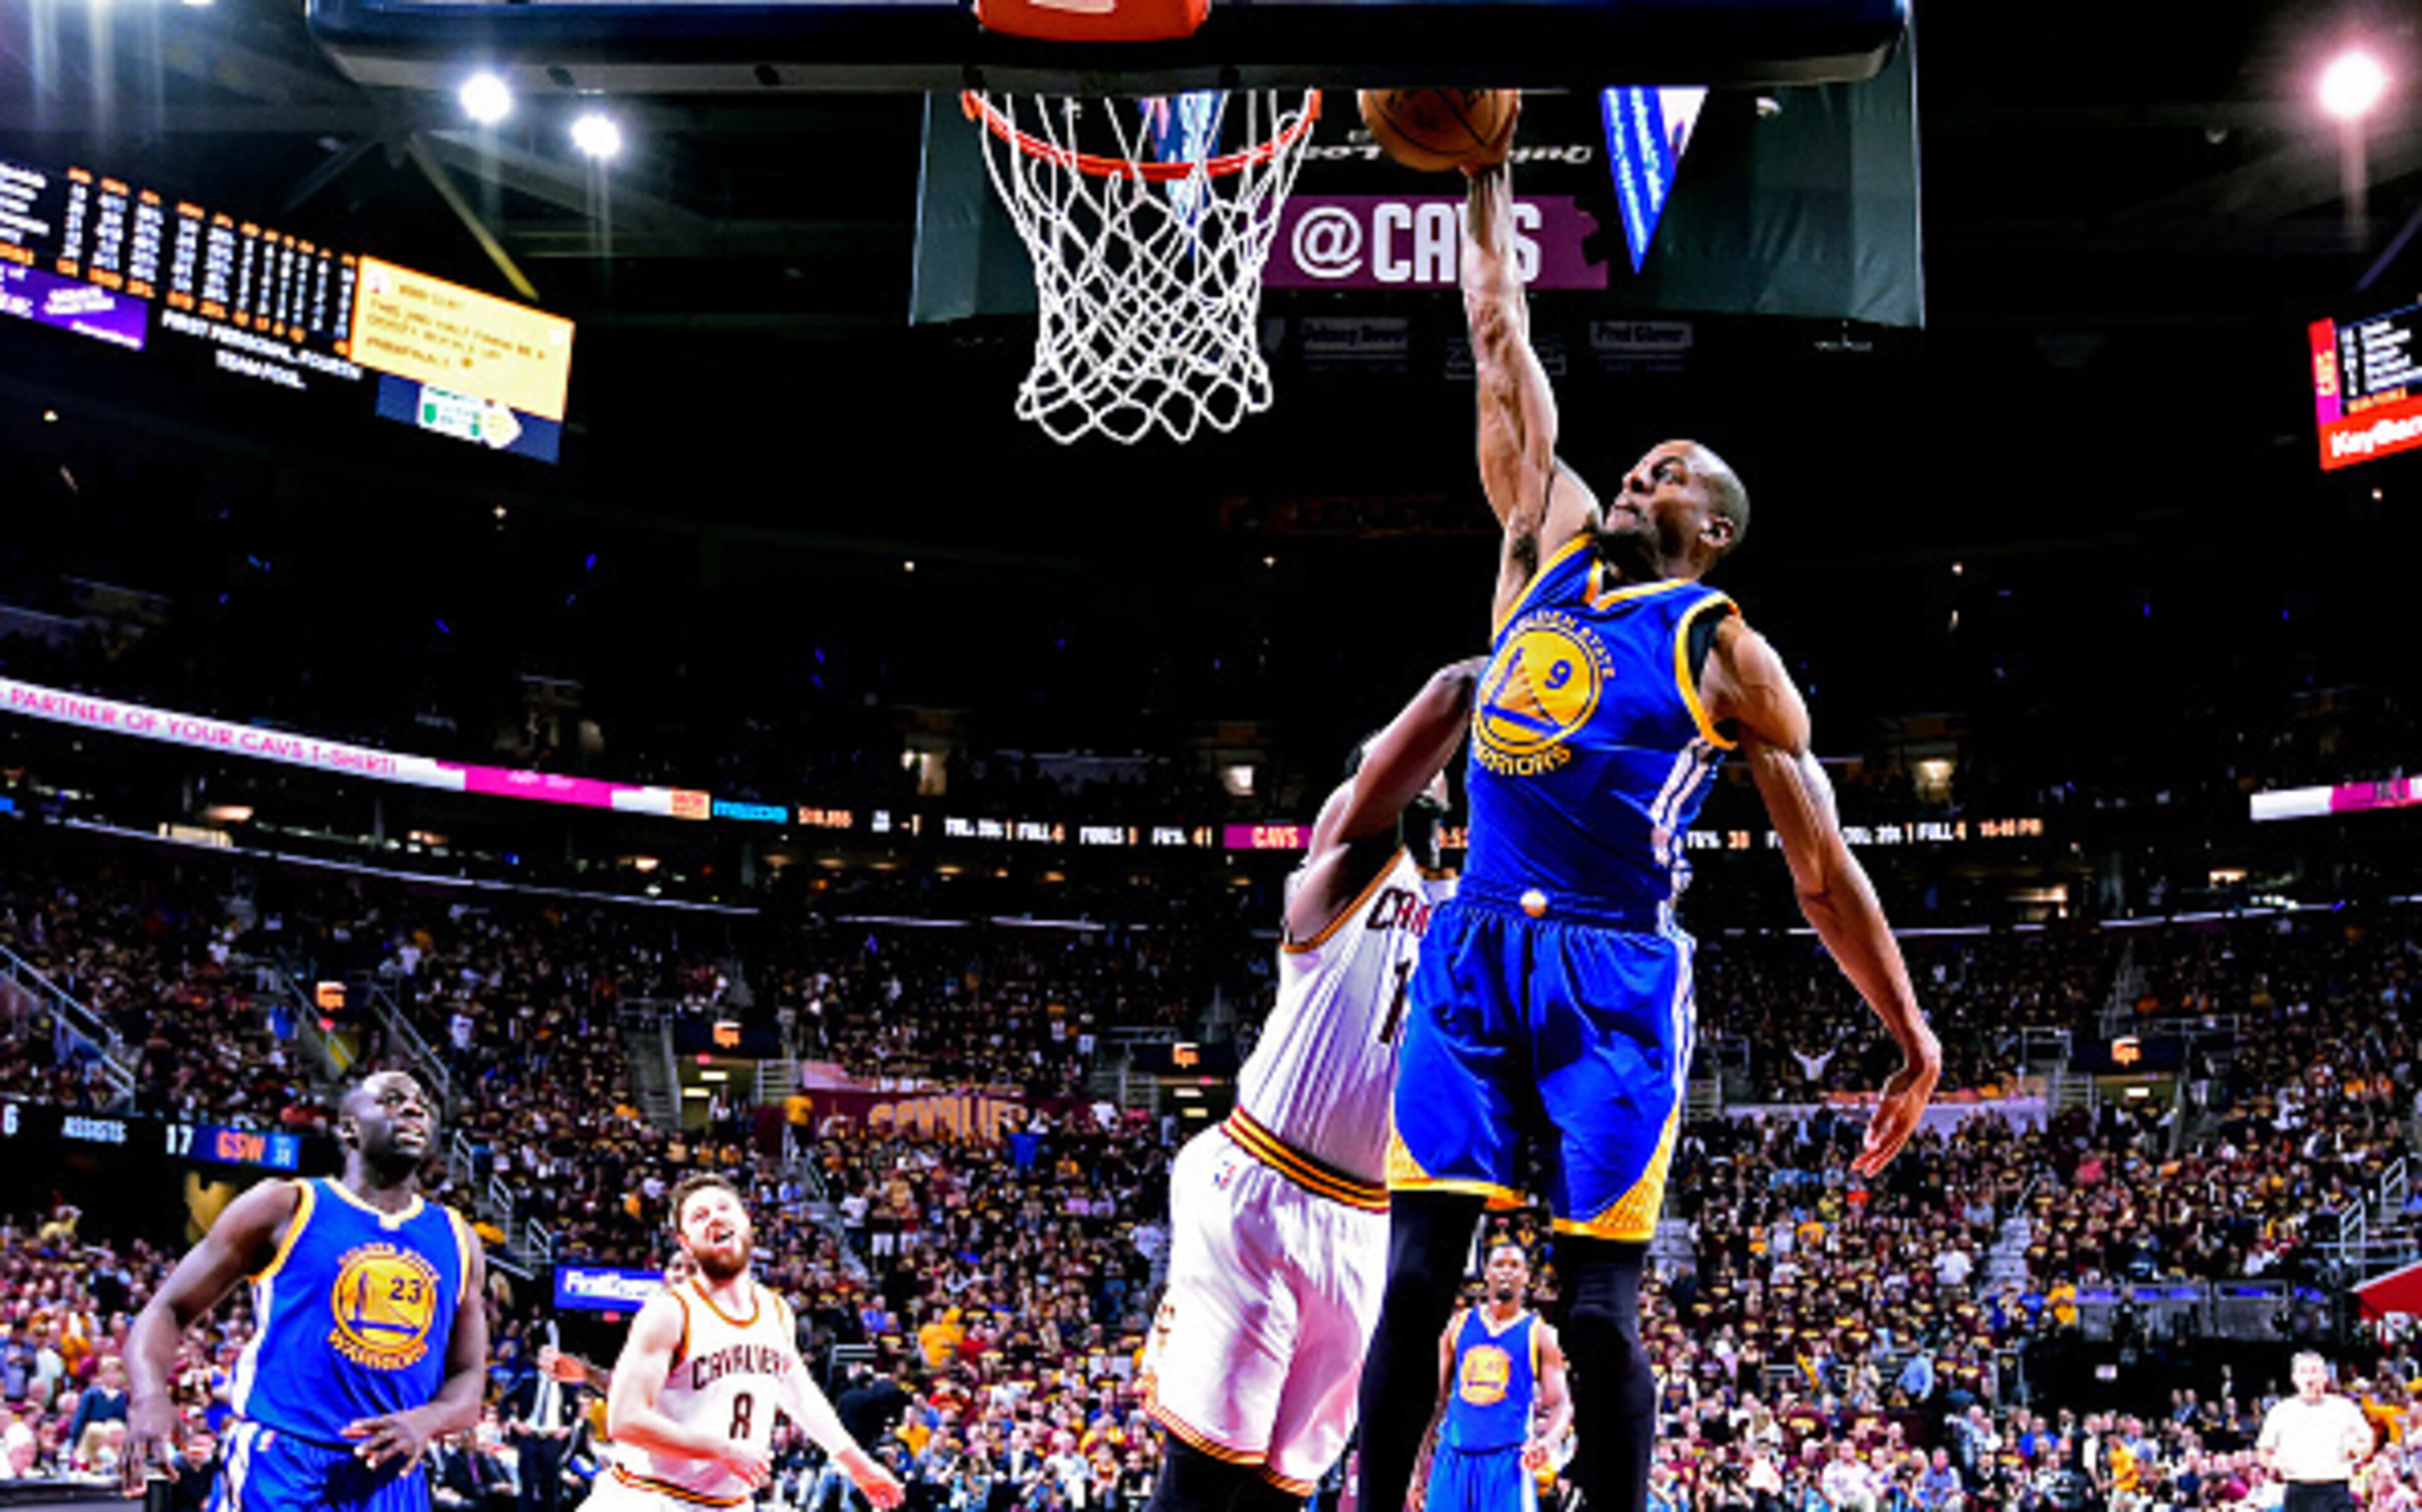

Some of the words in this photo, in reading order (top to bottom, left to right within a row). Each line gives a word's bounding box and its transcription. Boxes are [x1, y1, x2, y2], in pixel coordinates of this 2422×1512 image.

[1292, 202, 1542, 282] @CAS
[1544, 659, 1572, 690] 9
[11, 686, 118, 725] PARTNER
[126, 710, 158, 731] OF
[166, 716, 234, 746] YOUR
[239, 732, 303, 759] CAVS
[1251, 826, 1298, 849] CAVS
[165, 1124, 194, 1156] 17
[216, 1130, 266, 1162] GSW
[389, 1275, 422, 1305] 23
[729, 1390, 754, 1441] 8
